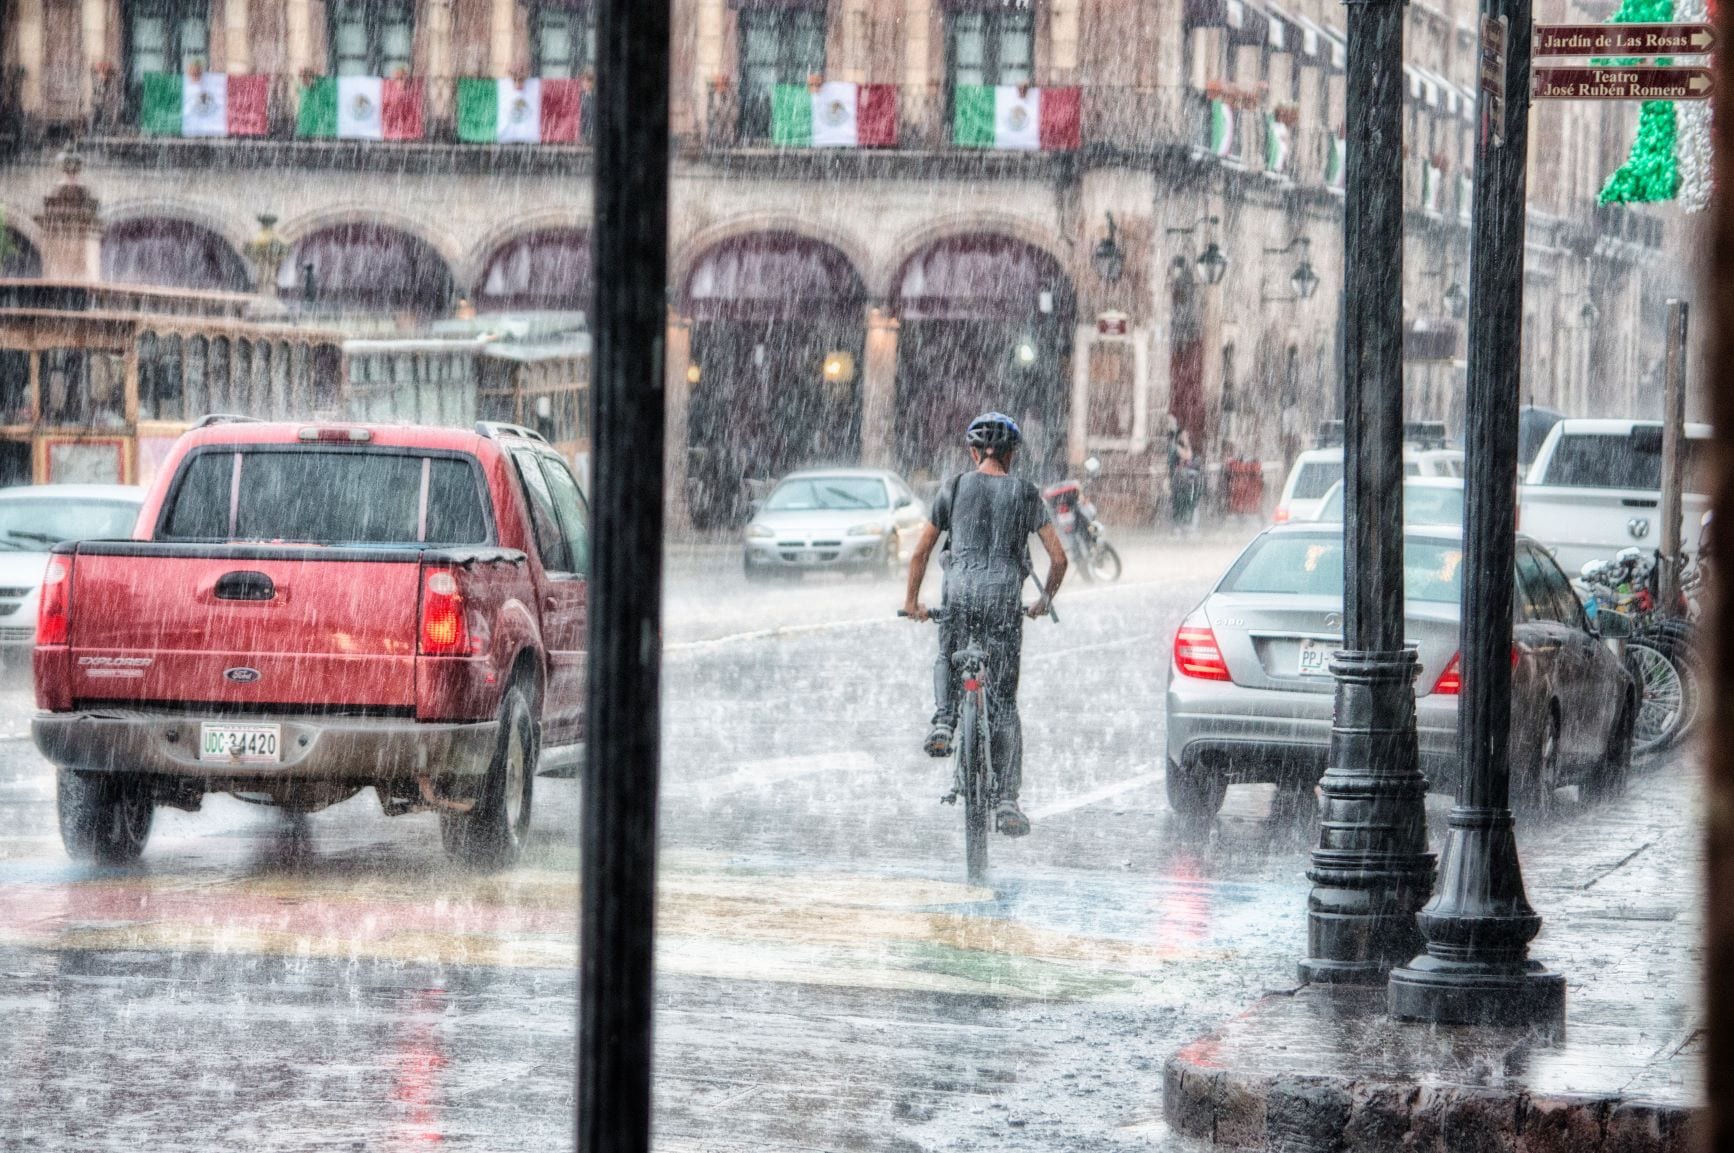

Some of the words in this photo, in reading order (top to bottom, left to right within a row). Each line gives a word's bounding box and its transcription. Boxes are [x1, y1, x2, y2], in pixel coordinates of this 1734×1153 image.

[1544, 34, 1591, 48] Jardín
[1595, 34, 1612, 47] de
[1616, 34, 1642, 47] Las
[1646, 33, 1688, 47] Rosas
[1593, 70, 1639, 83] Teatro
[1544, 83, 1575, 96] José
[1579, 83, 1625, 96] Rubén
[1629, 84, 1686, 96] Romero
[1302, 651, 1333, 666] PPJ-
